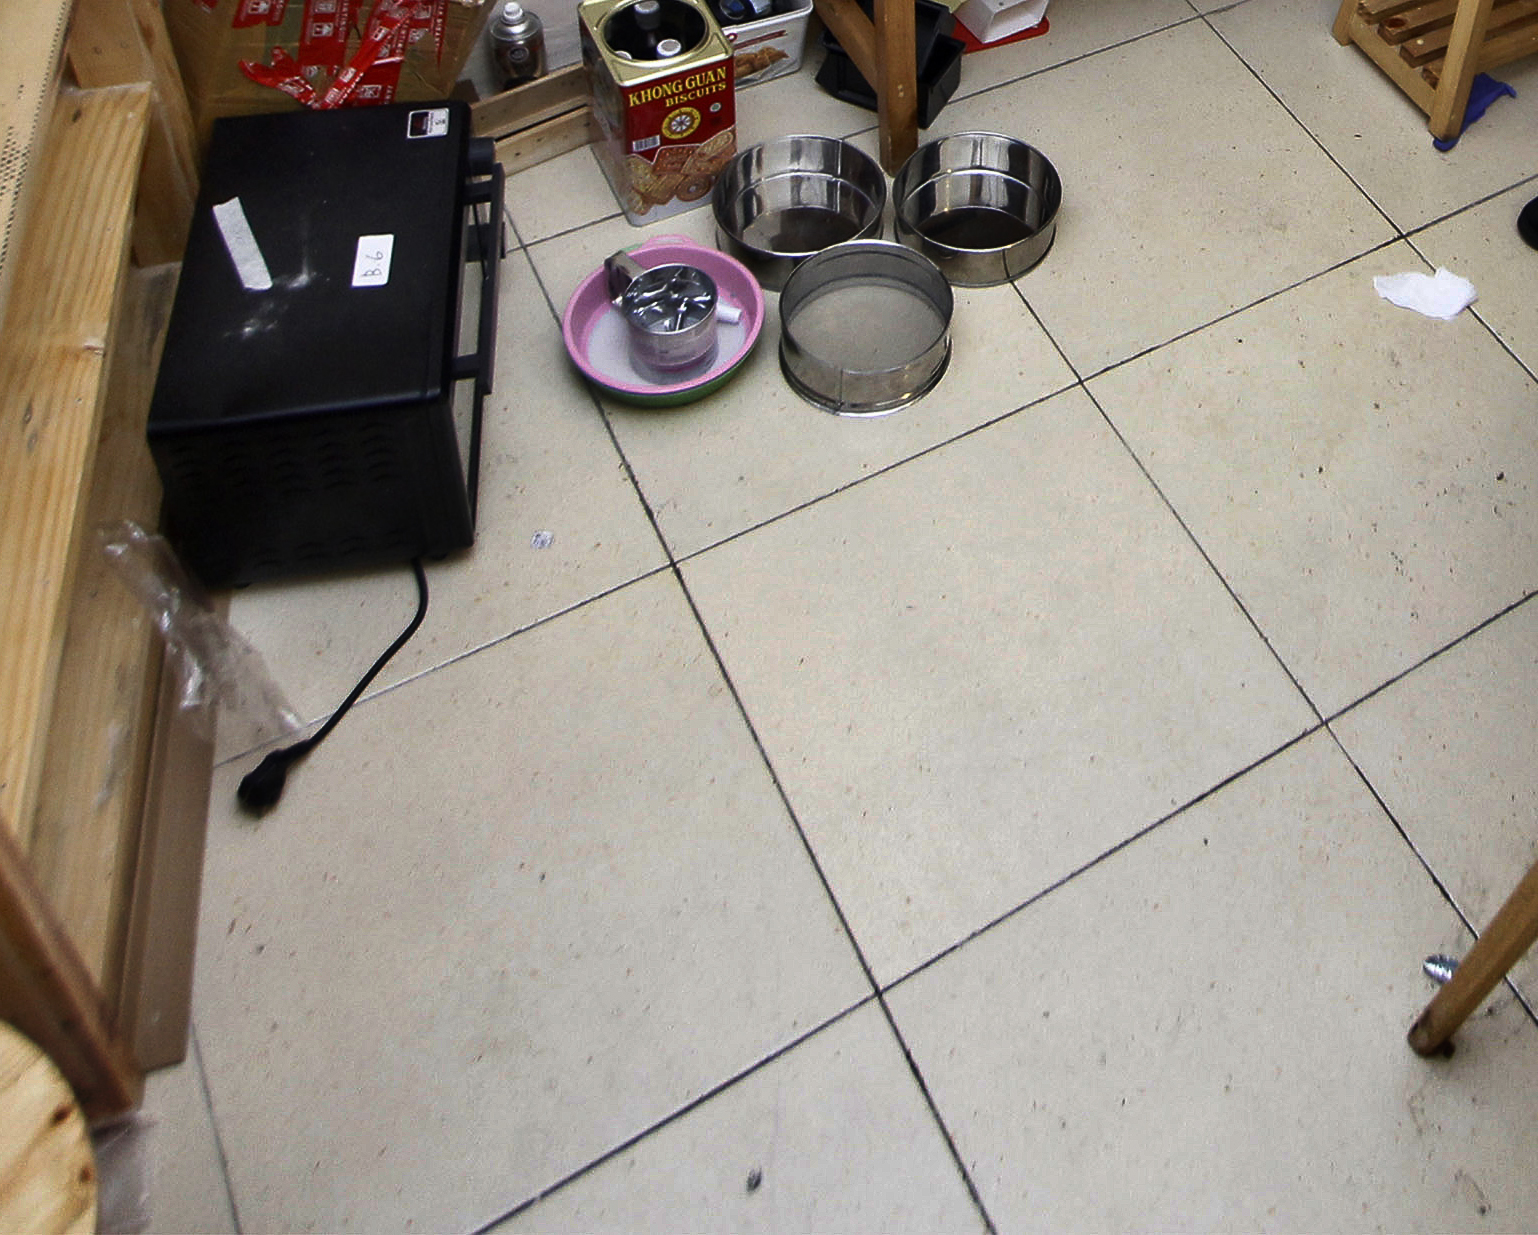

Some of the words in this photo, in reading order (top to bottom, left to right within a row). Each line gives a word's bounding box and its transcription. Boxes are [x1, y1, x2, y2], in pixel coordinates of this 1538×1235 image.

[627, 79, 684, 108] KHONG
[685, 65, 727, 90] GUAN
[665, 81, 727, 108] BISCUITS
